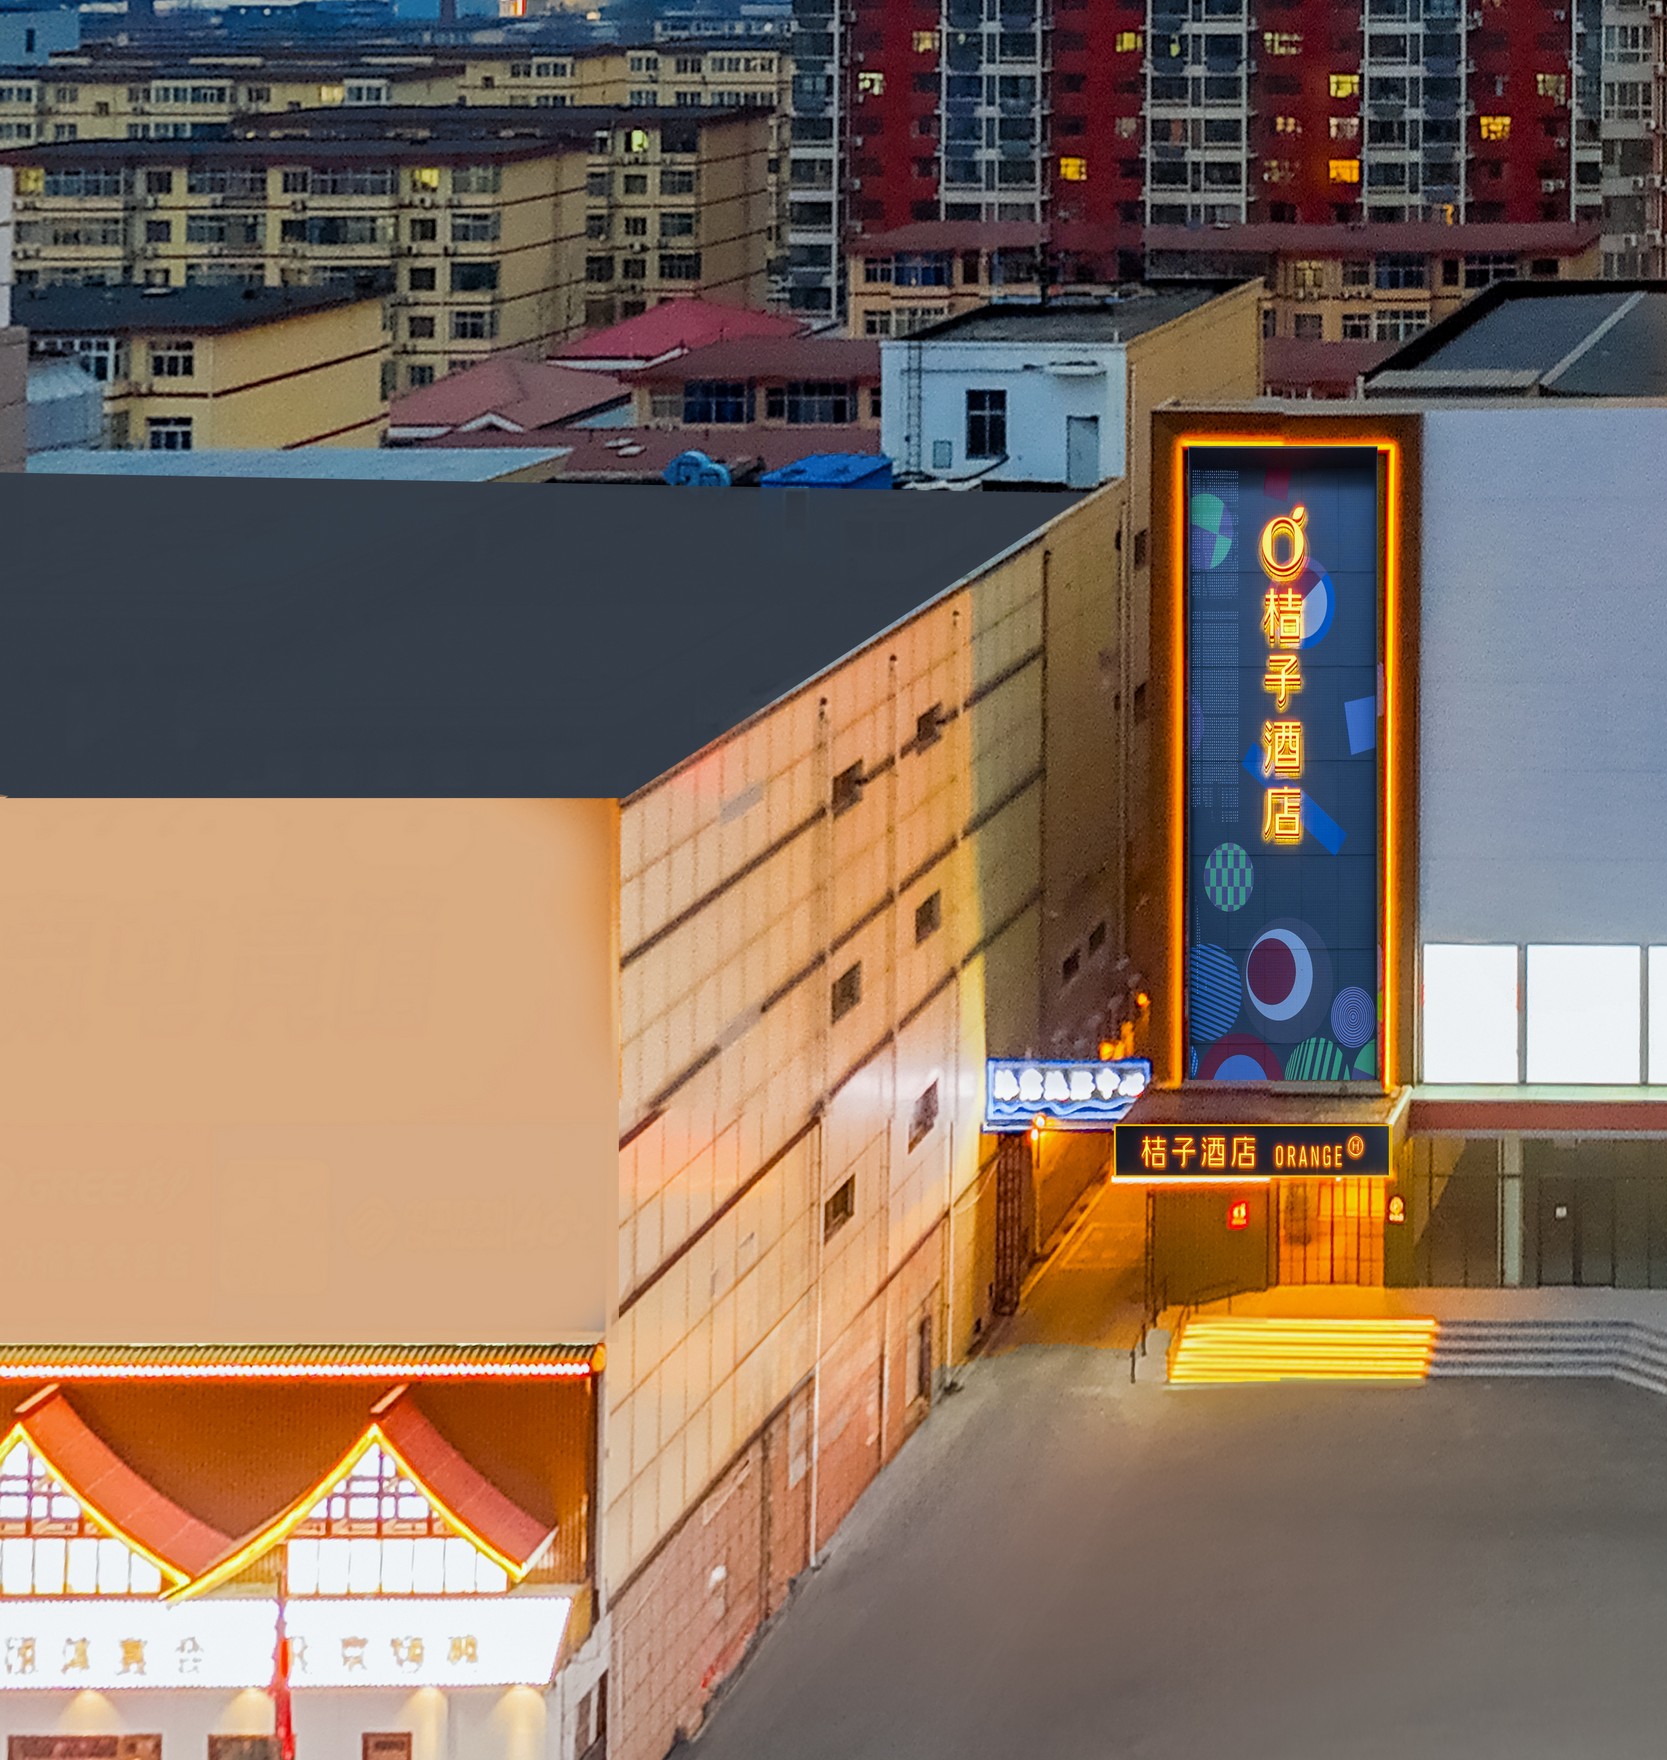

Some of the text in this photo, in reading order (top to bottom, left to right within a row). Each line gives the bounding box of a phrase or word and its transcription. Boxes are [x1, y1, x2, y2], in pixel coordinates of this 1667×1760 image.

[1263, 587, 1303, 846] 桔子酒店
[1141, 1135, 1257, 1169] 桔子酒店
[1273, 1144, 1344, 1168] ORANGE
